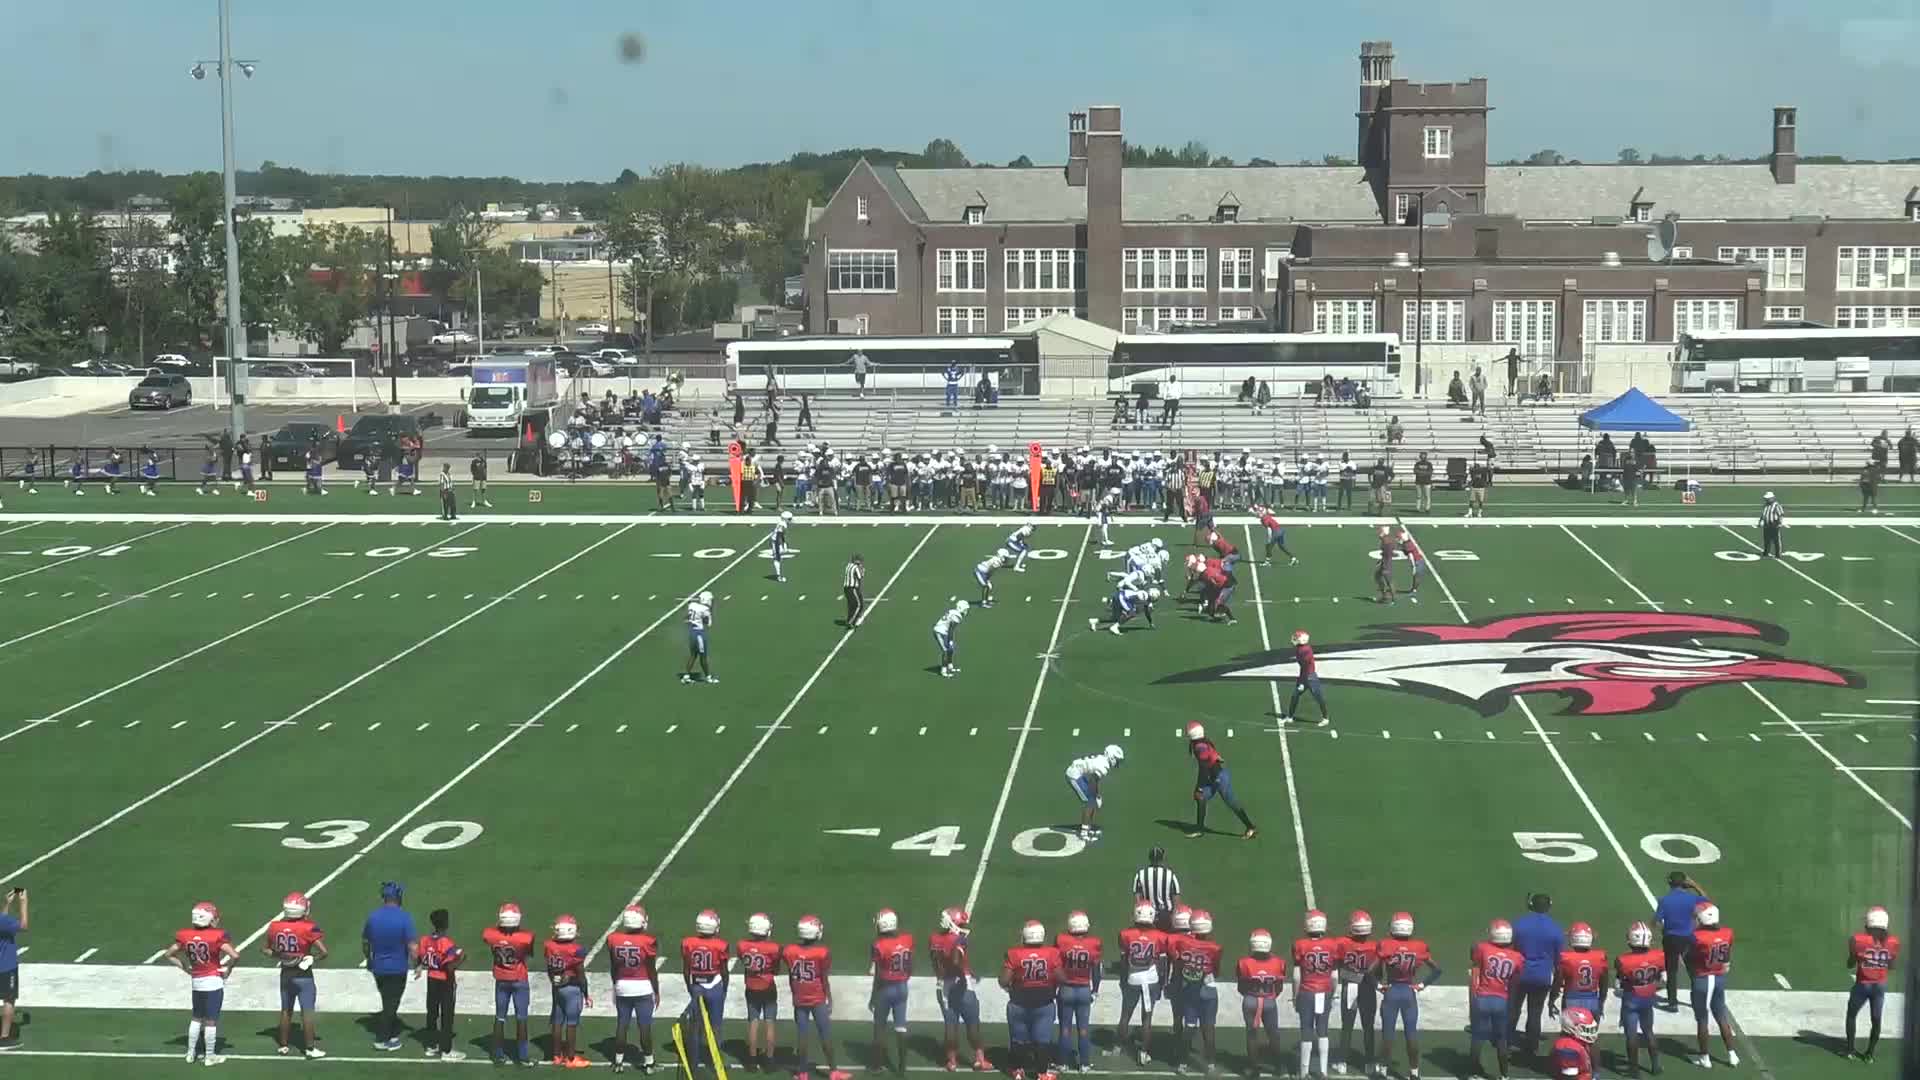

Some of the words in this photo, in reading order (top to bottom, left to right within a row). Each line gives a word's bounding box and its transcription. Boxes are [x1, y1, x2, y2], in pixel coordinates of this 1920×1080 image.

[281, 819, 484, 850] 30
[891, 825, 1087, 857] 40
[1512, 832, 1722, 864] 50
[615, 947, 640, 968] 55
[691, 952, 715, 971] 31
[1305, 951, 1330, 973] 35
[1487, 956, 1514, 981] 30
[791, 960, 817, 982] 45
[1020, 959, 1046, 981] 72
[1577, 966, 1593, 987] 3
